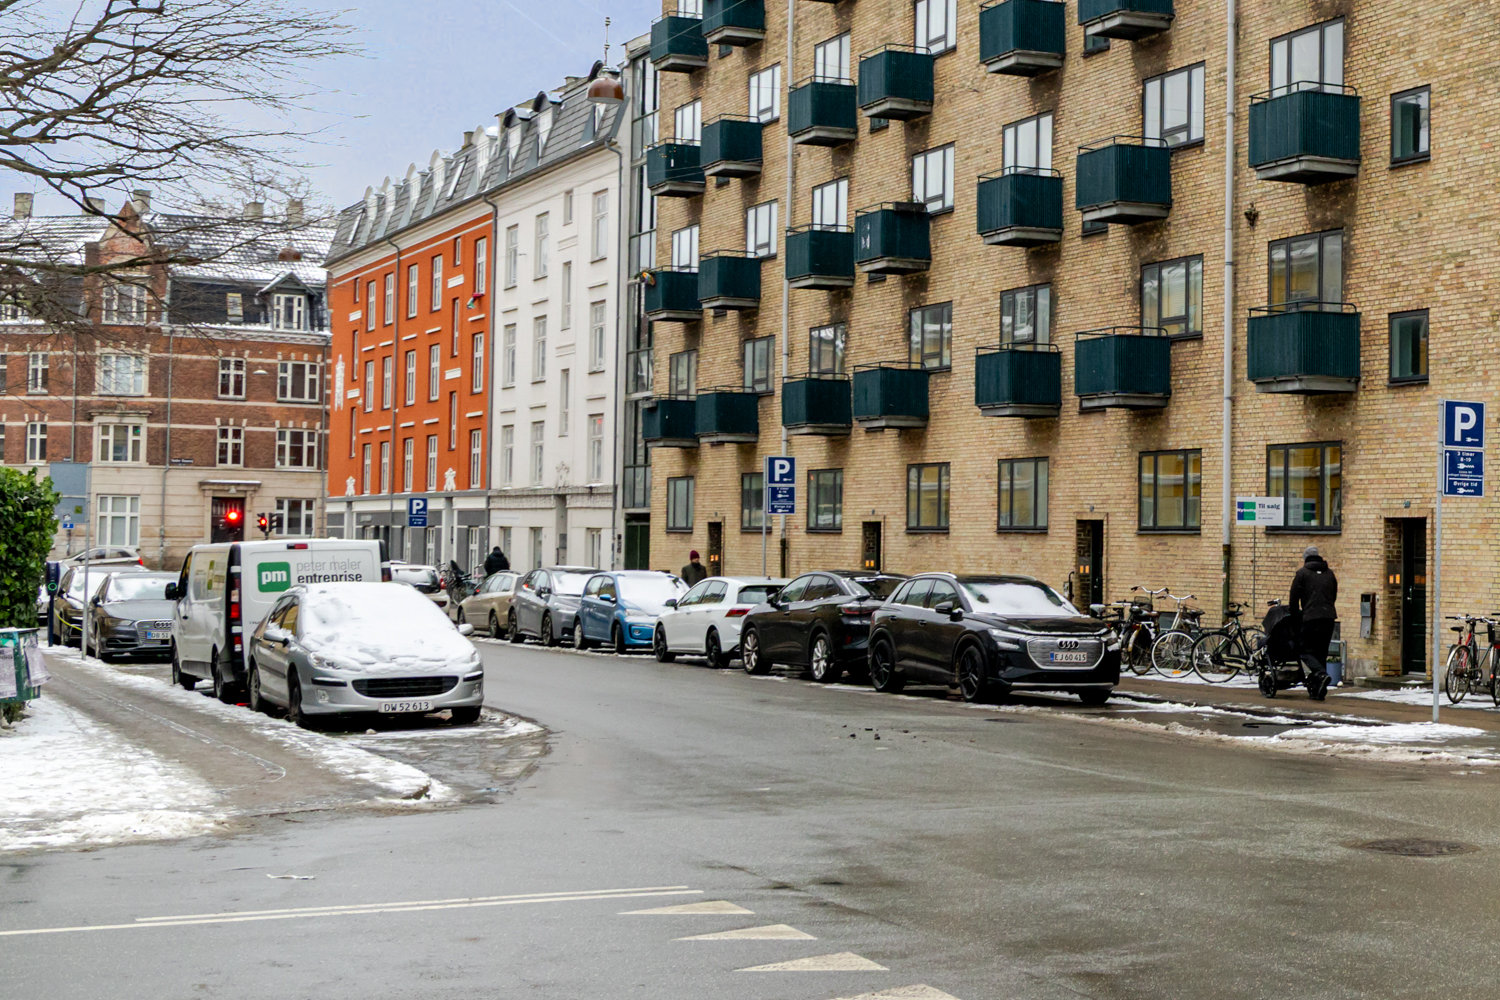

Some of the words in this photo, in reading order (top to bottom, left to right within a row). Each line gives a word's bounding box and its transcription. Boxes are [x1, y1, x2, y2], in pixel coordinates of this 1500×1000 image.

[1454, 406, 1477, 442] P
[774, 459, 791, 482] P
[1453, 480, 1470, 488] Øvrige
[412, 499, 425, 515] P
[296, 561, 325, 574] peter
[330, 558, 362, 571] maler
[261, 571, 288, 585] pm
[1054, 653, 1064, 661] EJ
[1065, 653, 1073, 661] 60
[384, 703, 398, 712] DW
[400, 702, 410, 711] 52
[412, 701, 430, 711] 613
